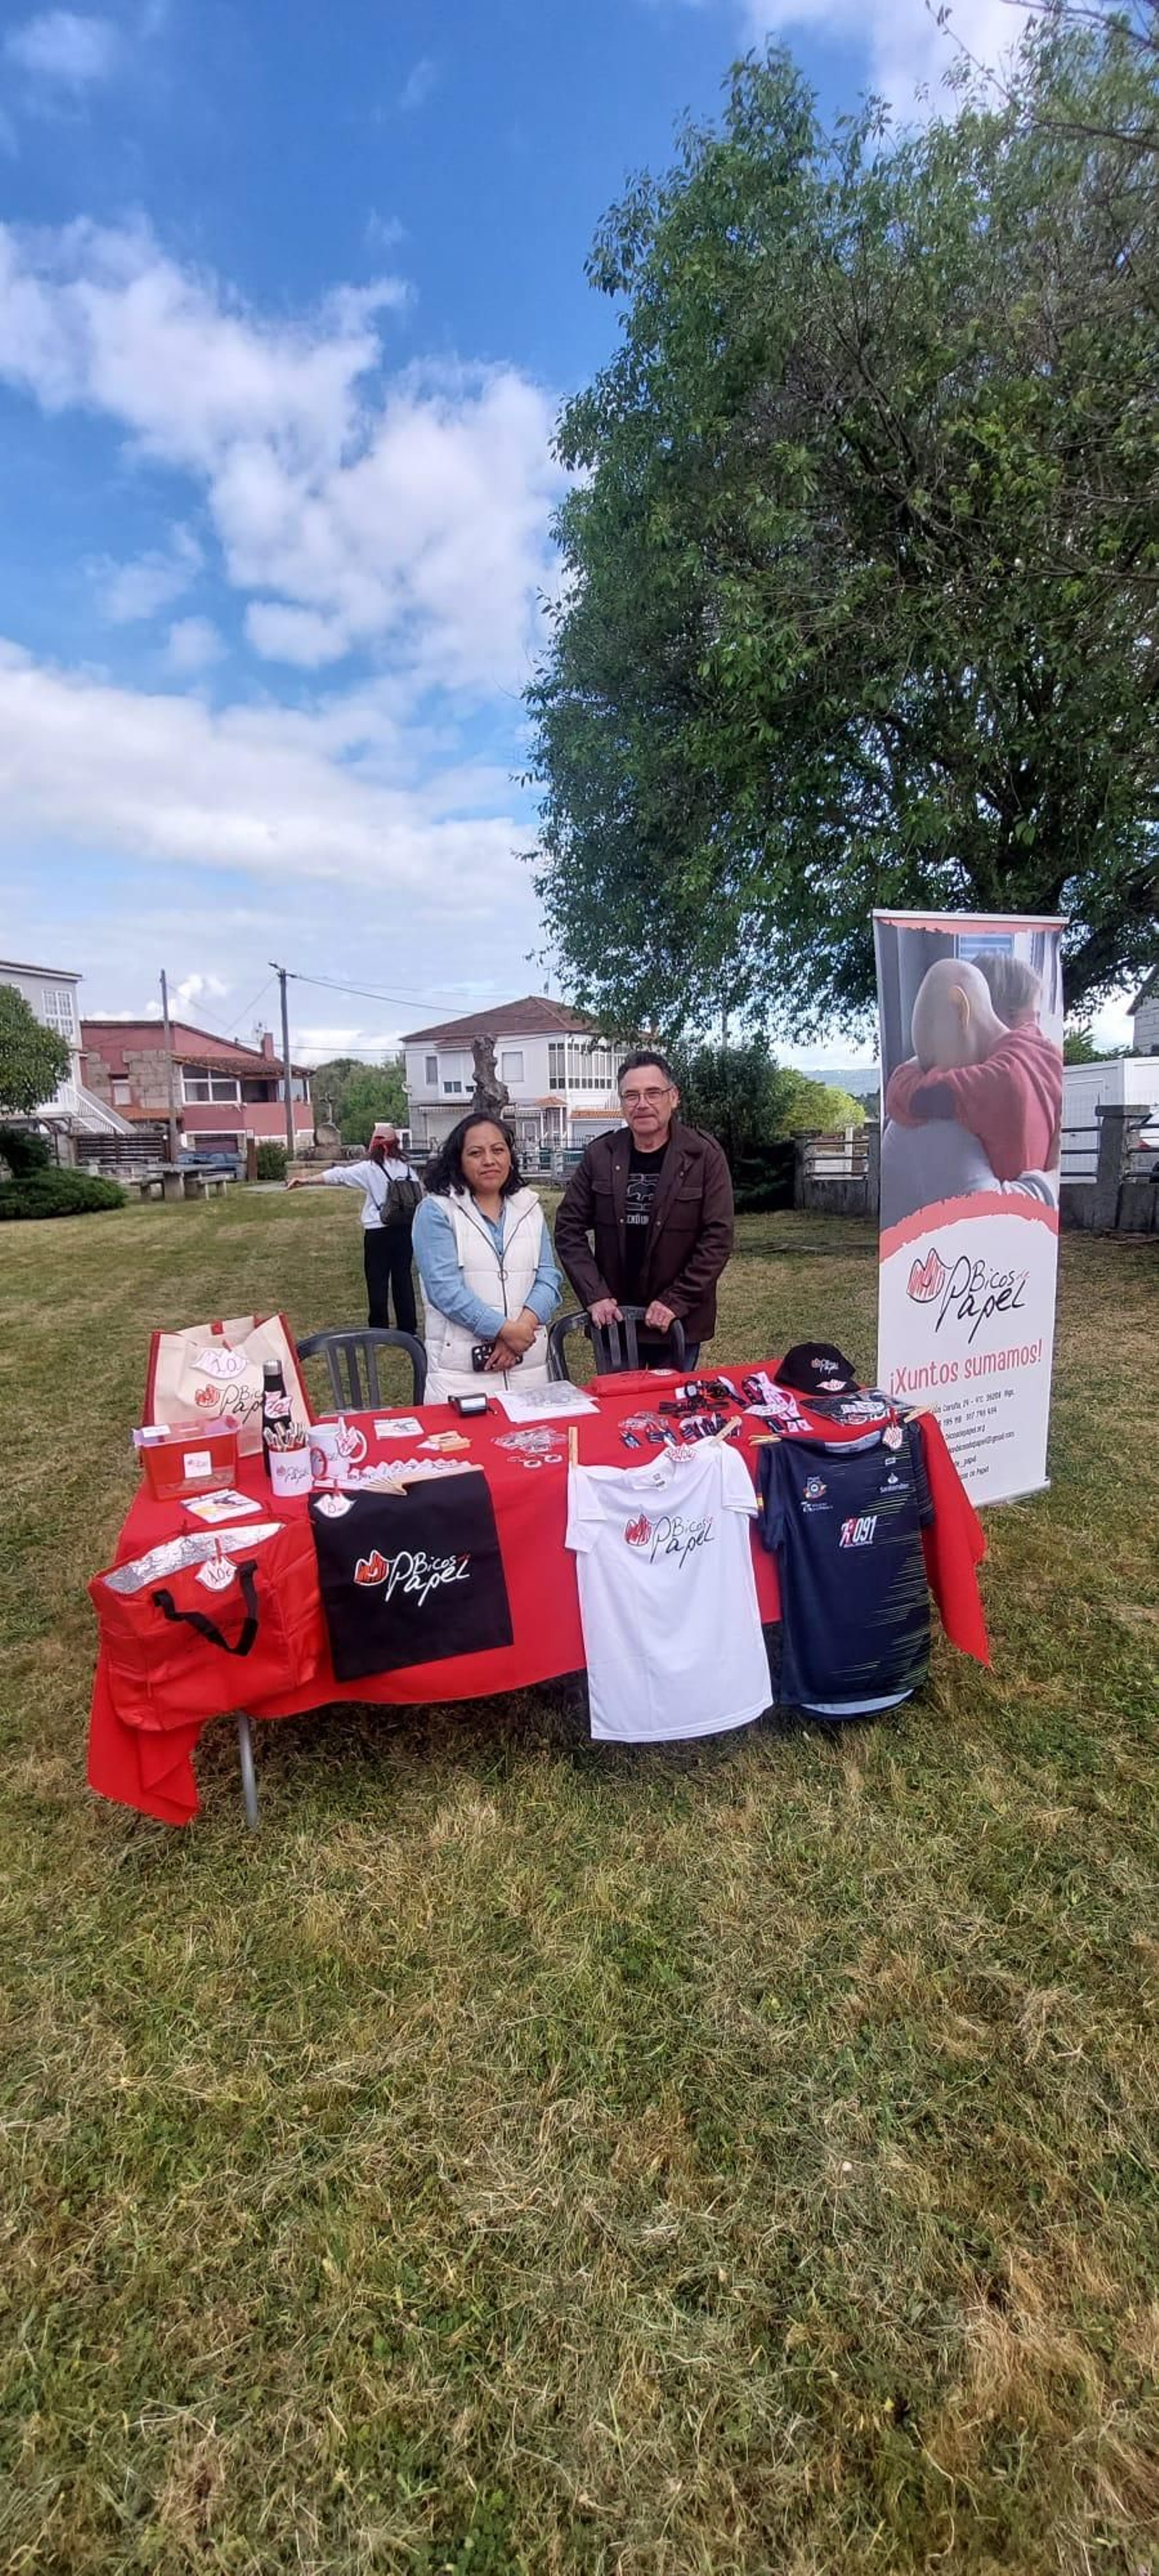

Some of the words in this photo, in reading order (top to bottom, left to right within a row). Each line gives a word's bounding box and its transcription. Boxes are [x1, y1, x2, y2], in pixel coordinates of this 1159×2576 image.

[935, 1255, 1026, 1345] Papel
[969, 1260, 1016, 1292] Bicos
[890, 1361, 958, 1397] ¡Xuntos
[964, 1339, 1042, 1379] sumamos!
[650, 1516, 716, 1569] Papel
[671, 1516, 706, 1537] Bicos
[385, 1552, 470, 1607] Papel
[413, 1552, 456, 1574] Bicos
